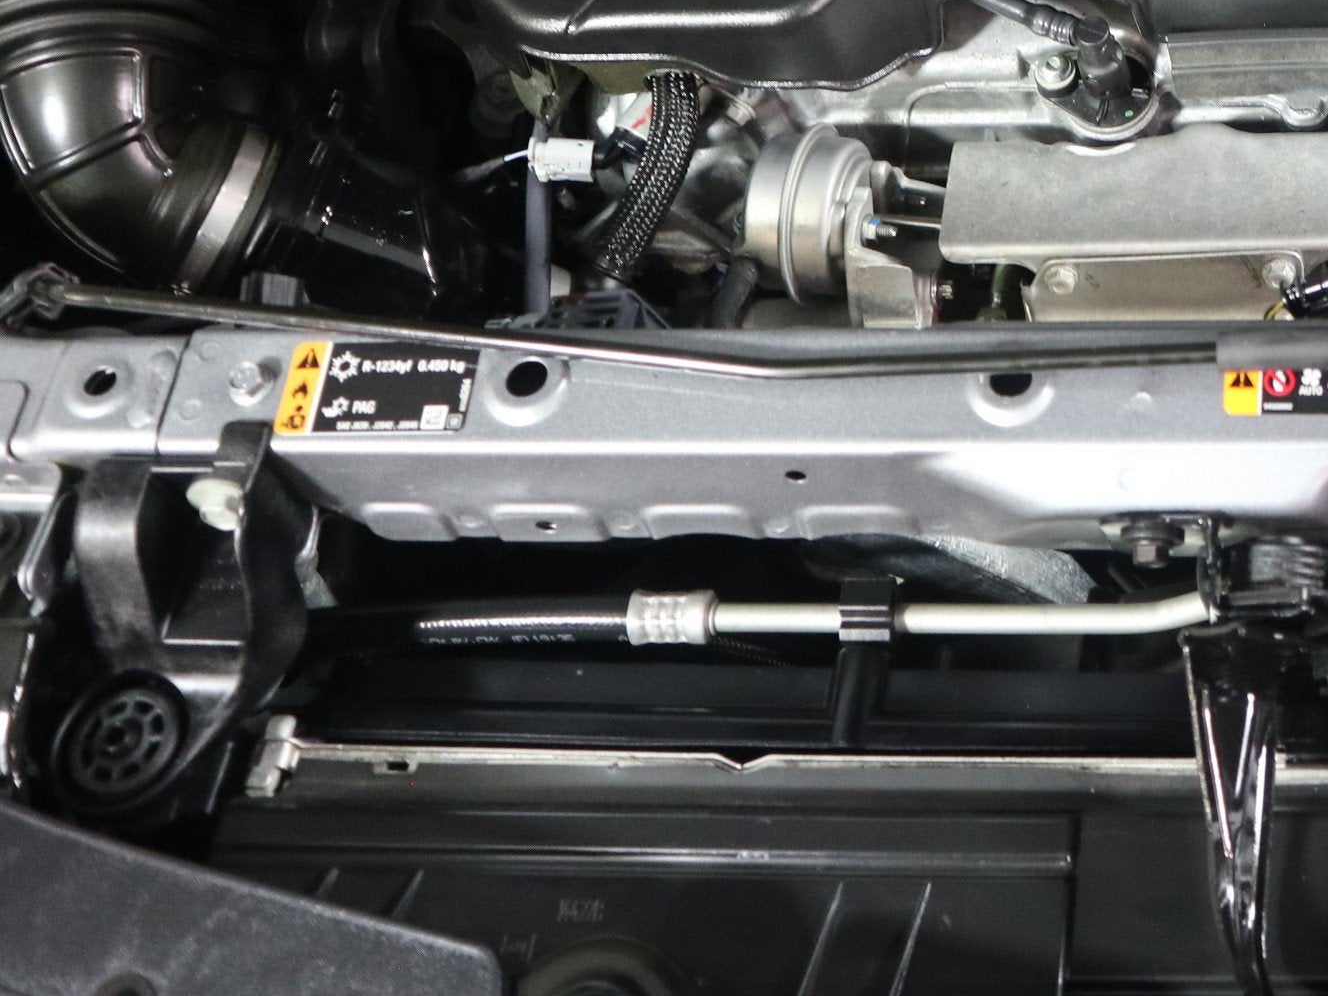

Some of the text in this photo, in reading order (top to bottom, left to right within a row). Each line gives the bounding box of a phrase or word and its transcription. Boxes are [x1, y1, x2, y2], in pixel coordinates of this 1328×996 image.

[361, 359, 413, 375] R-1234yf
[1298, 385, 1324, 396] AUTO
[351, 400, 377, 414] PAG
